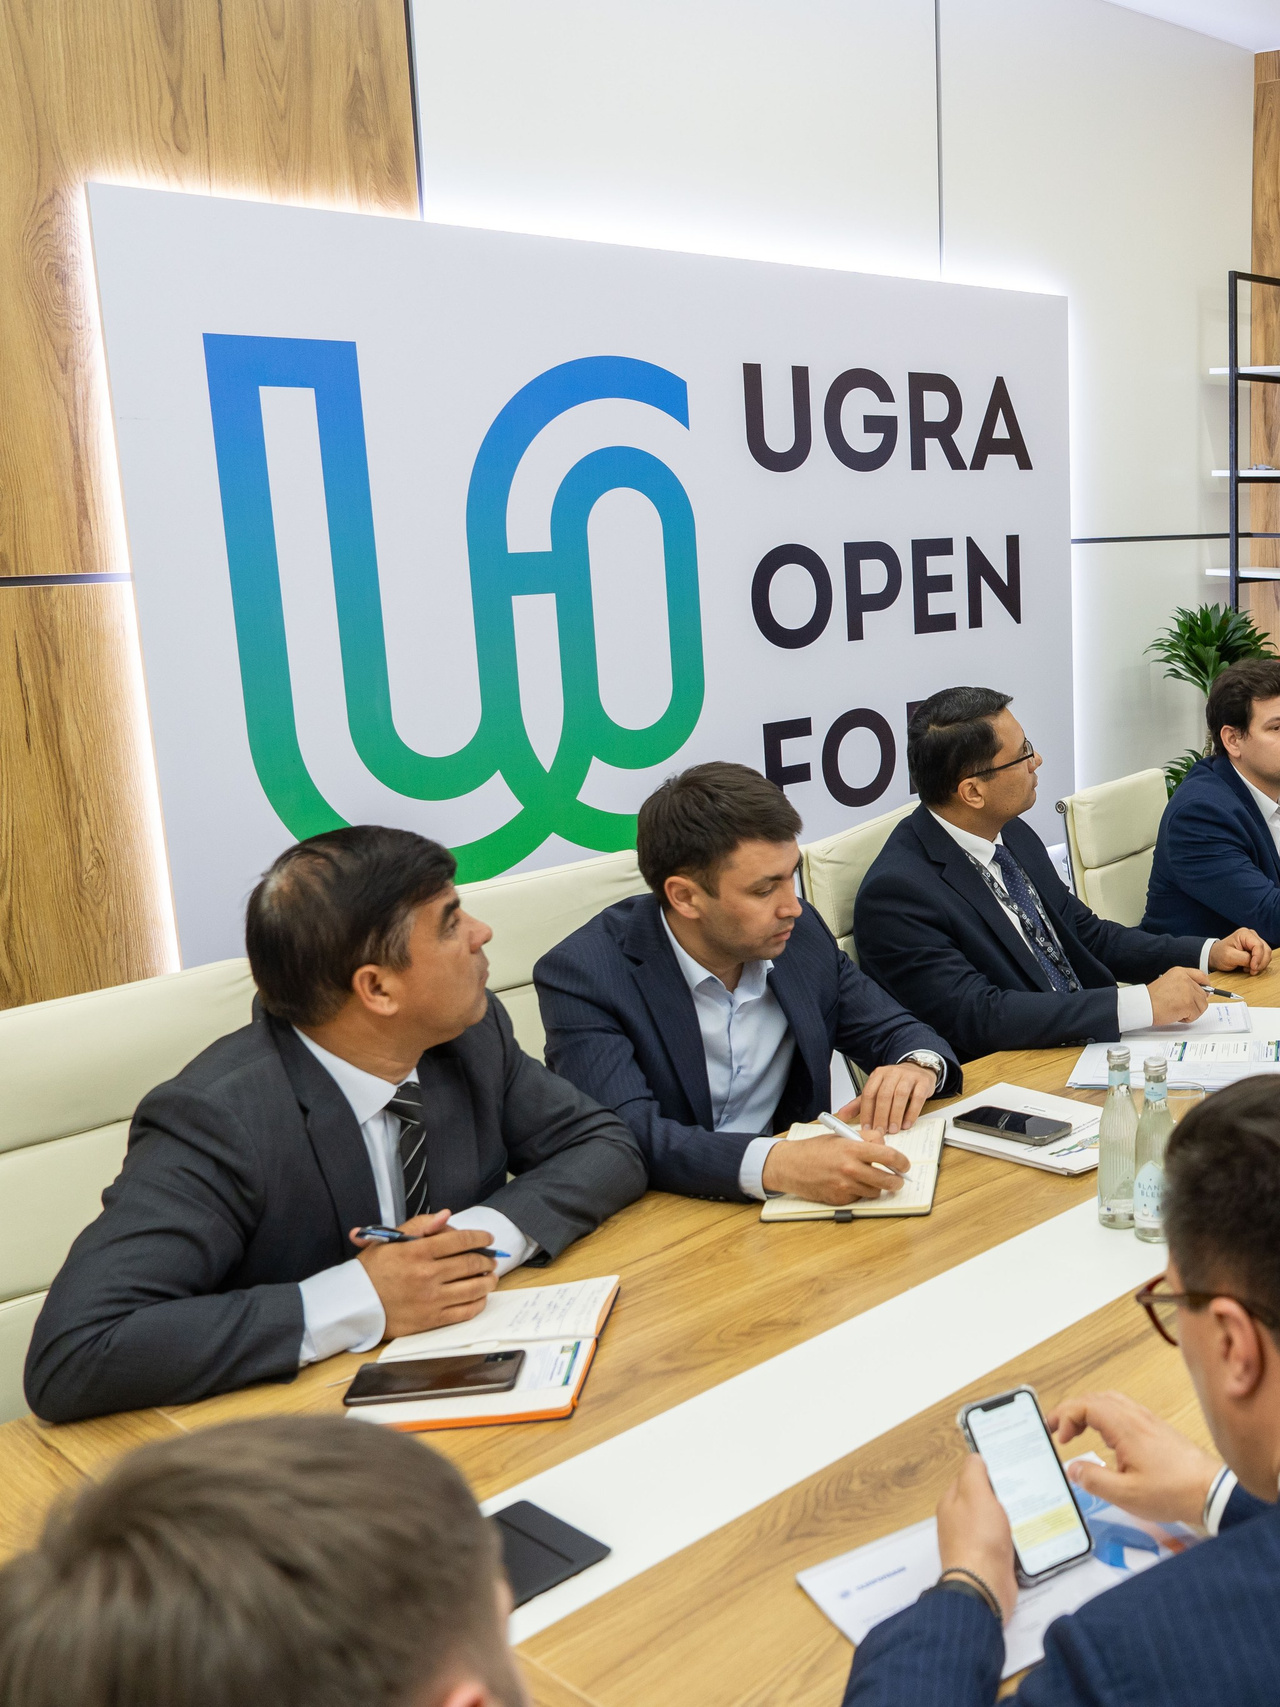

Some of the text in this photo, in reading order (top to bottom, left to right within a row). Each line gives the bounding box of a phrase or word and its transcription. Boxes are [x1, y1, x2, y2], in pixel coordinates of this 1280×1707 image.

[742, 362, 1033, 473] UGRA
[751, 534, 1022, 649] OPEN
[762, 699, 929, 808] FO
